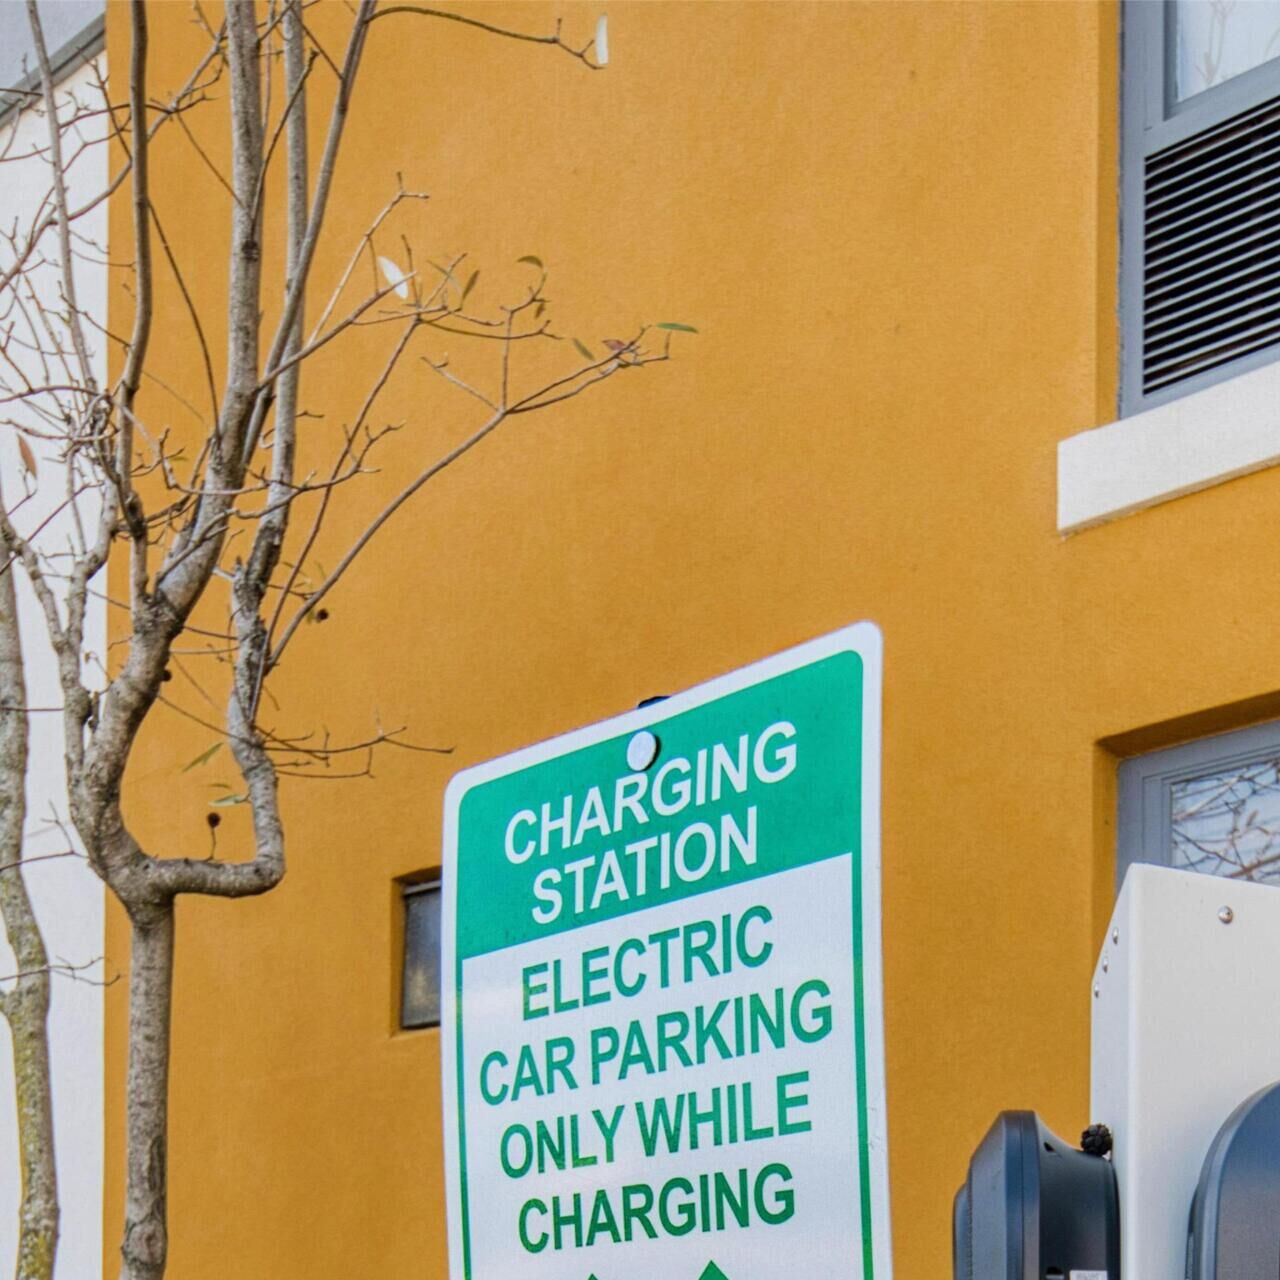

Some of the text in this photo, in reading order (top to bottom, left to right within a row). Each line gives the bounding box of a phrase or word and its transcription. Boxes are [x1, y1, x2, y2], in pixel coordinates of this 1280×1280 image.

[505, 721, 798, 865] CHARGING
[530, 807, 758, 925] STATION
[522, 905, 773, 1021] ELECTRIC
[480, 979, 832, 1106] CAR PARKING
[500, 1071, 812, 1179] ONLY WHILE
[519, 1163, 795, 1254] CHARGING
